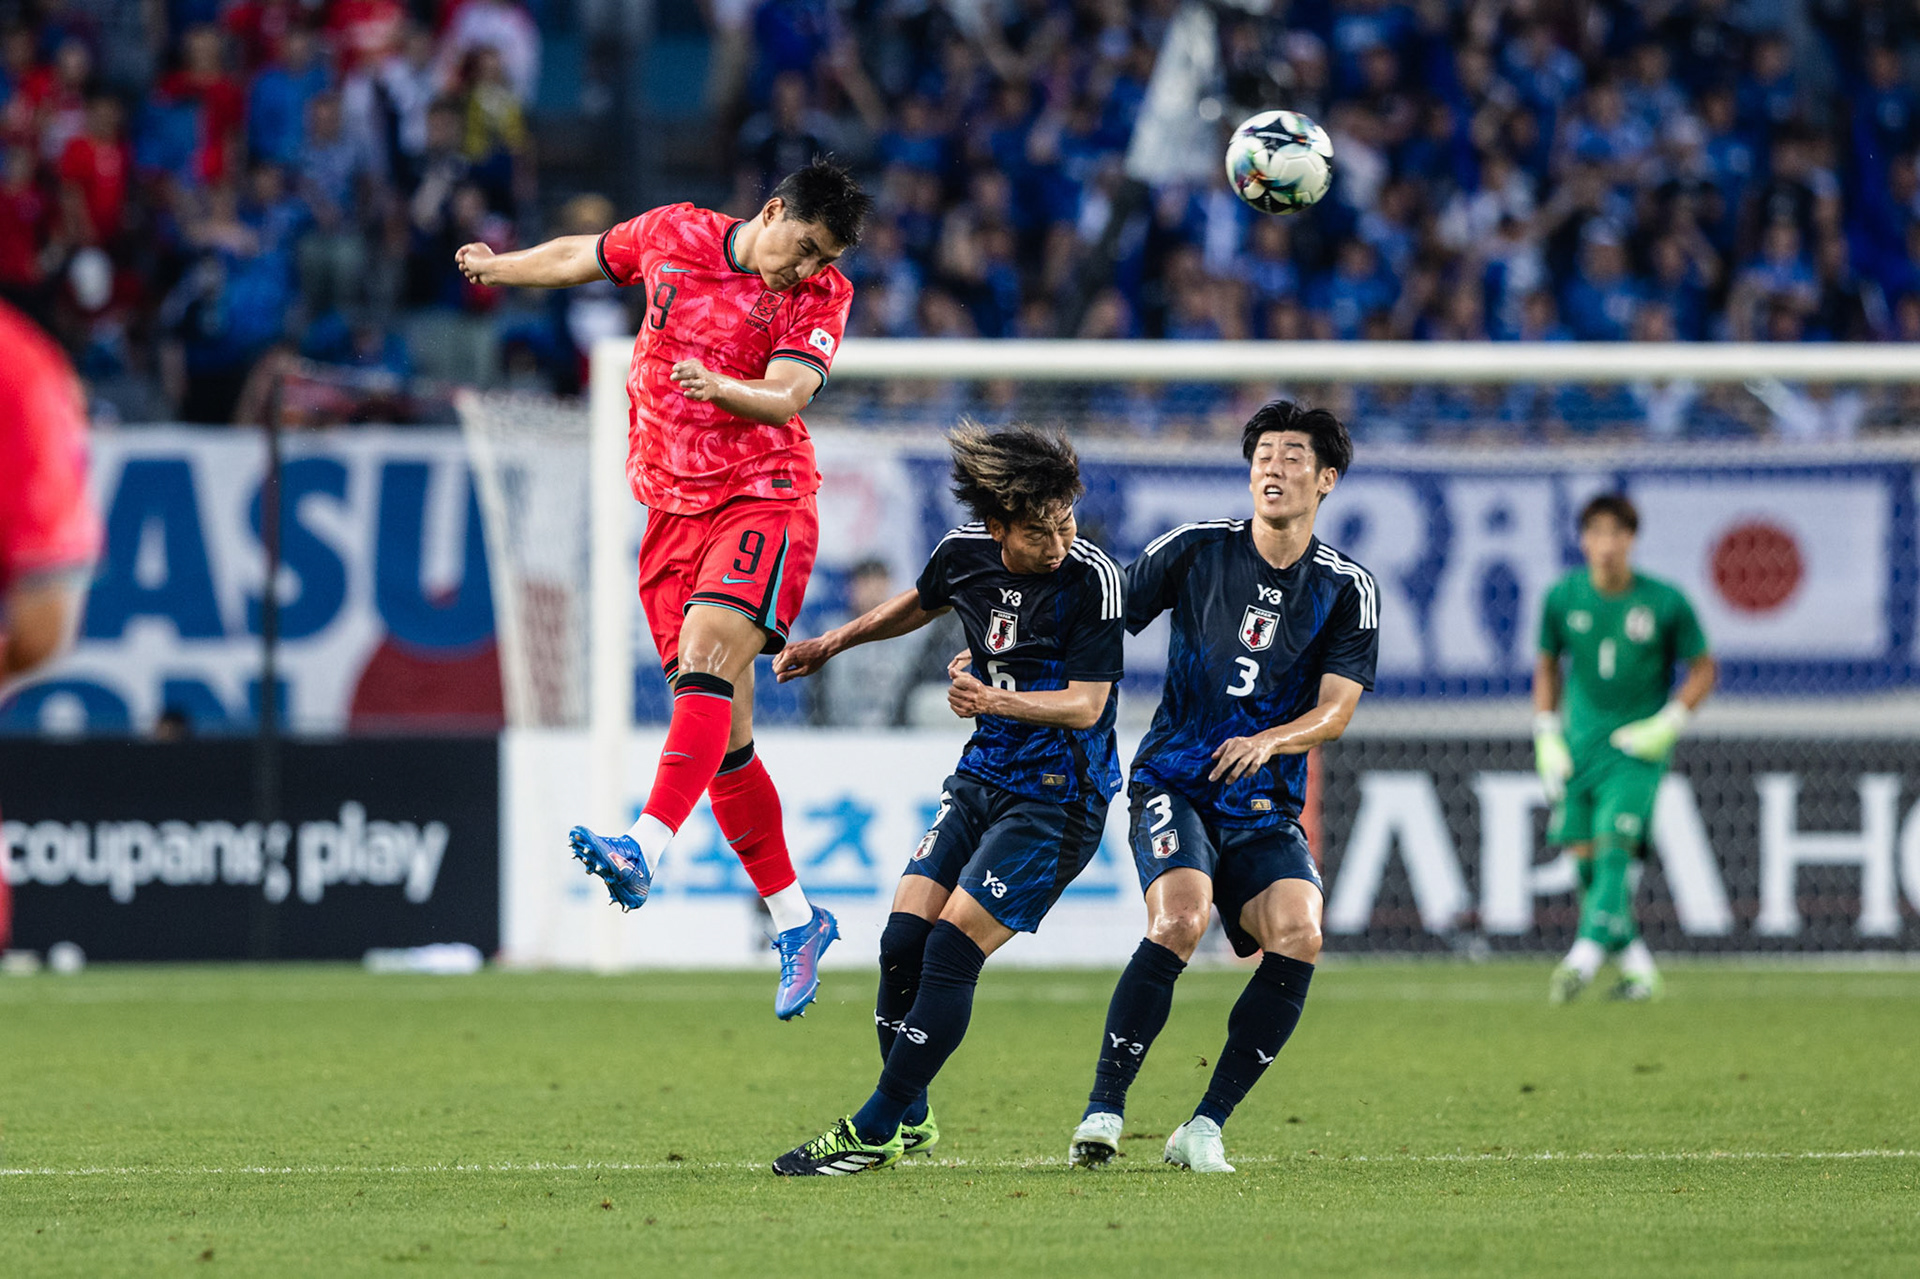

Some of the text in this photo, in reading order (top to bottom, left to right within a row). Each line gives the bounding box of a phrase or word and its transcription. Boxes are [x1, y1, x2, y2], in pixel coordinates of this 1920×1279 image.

[651, 281, 677, 330] 9
[733, 529, 765, 575] 9
[1226, 656, 1260, 697] 3
[1145, 793, 1173, 834] 3
[298, 800, 450, 902] play
